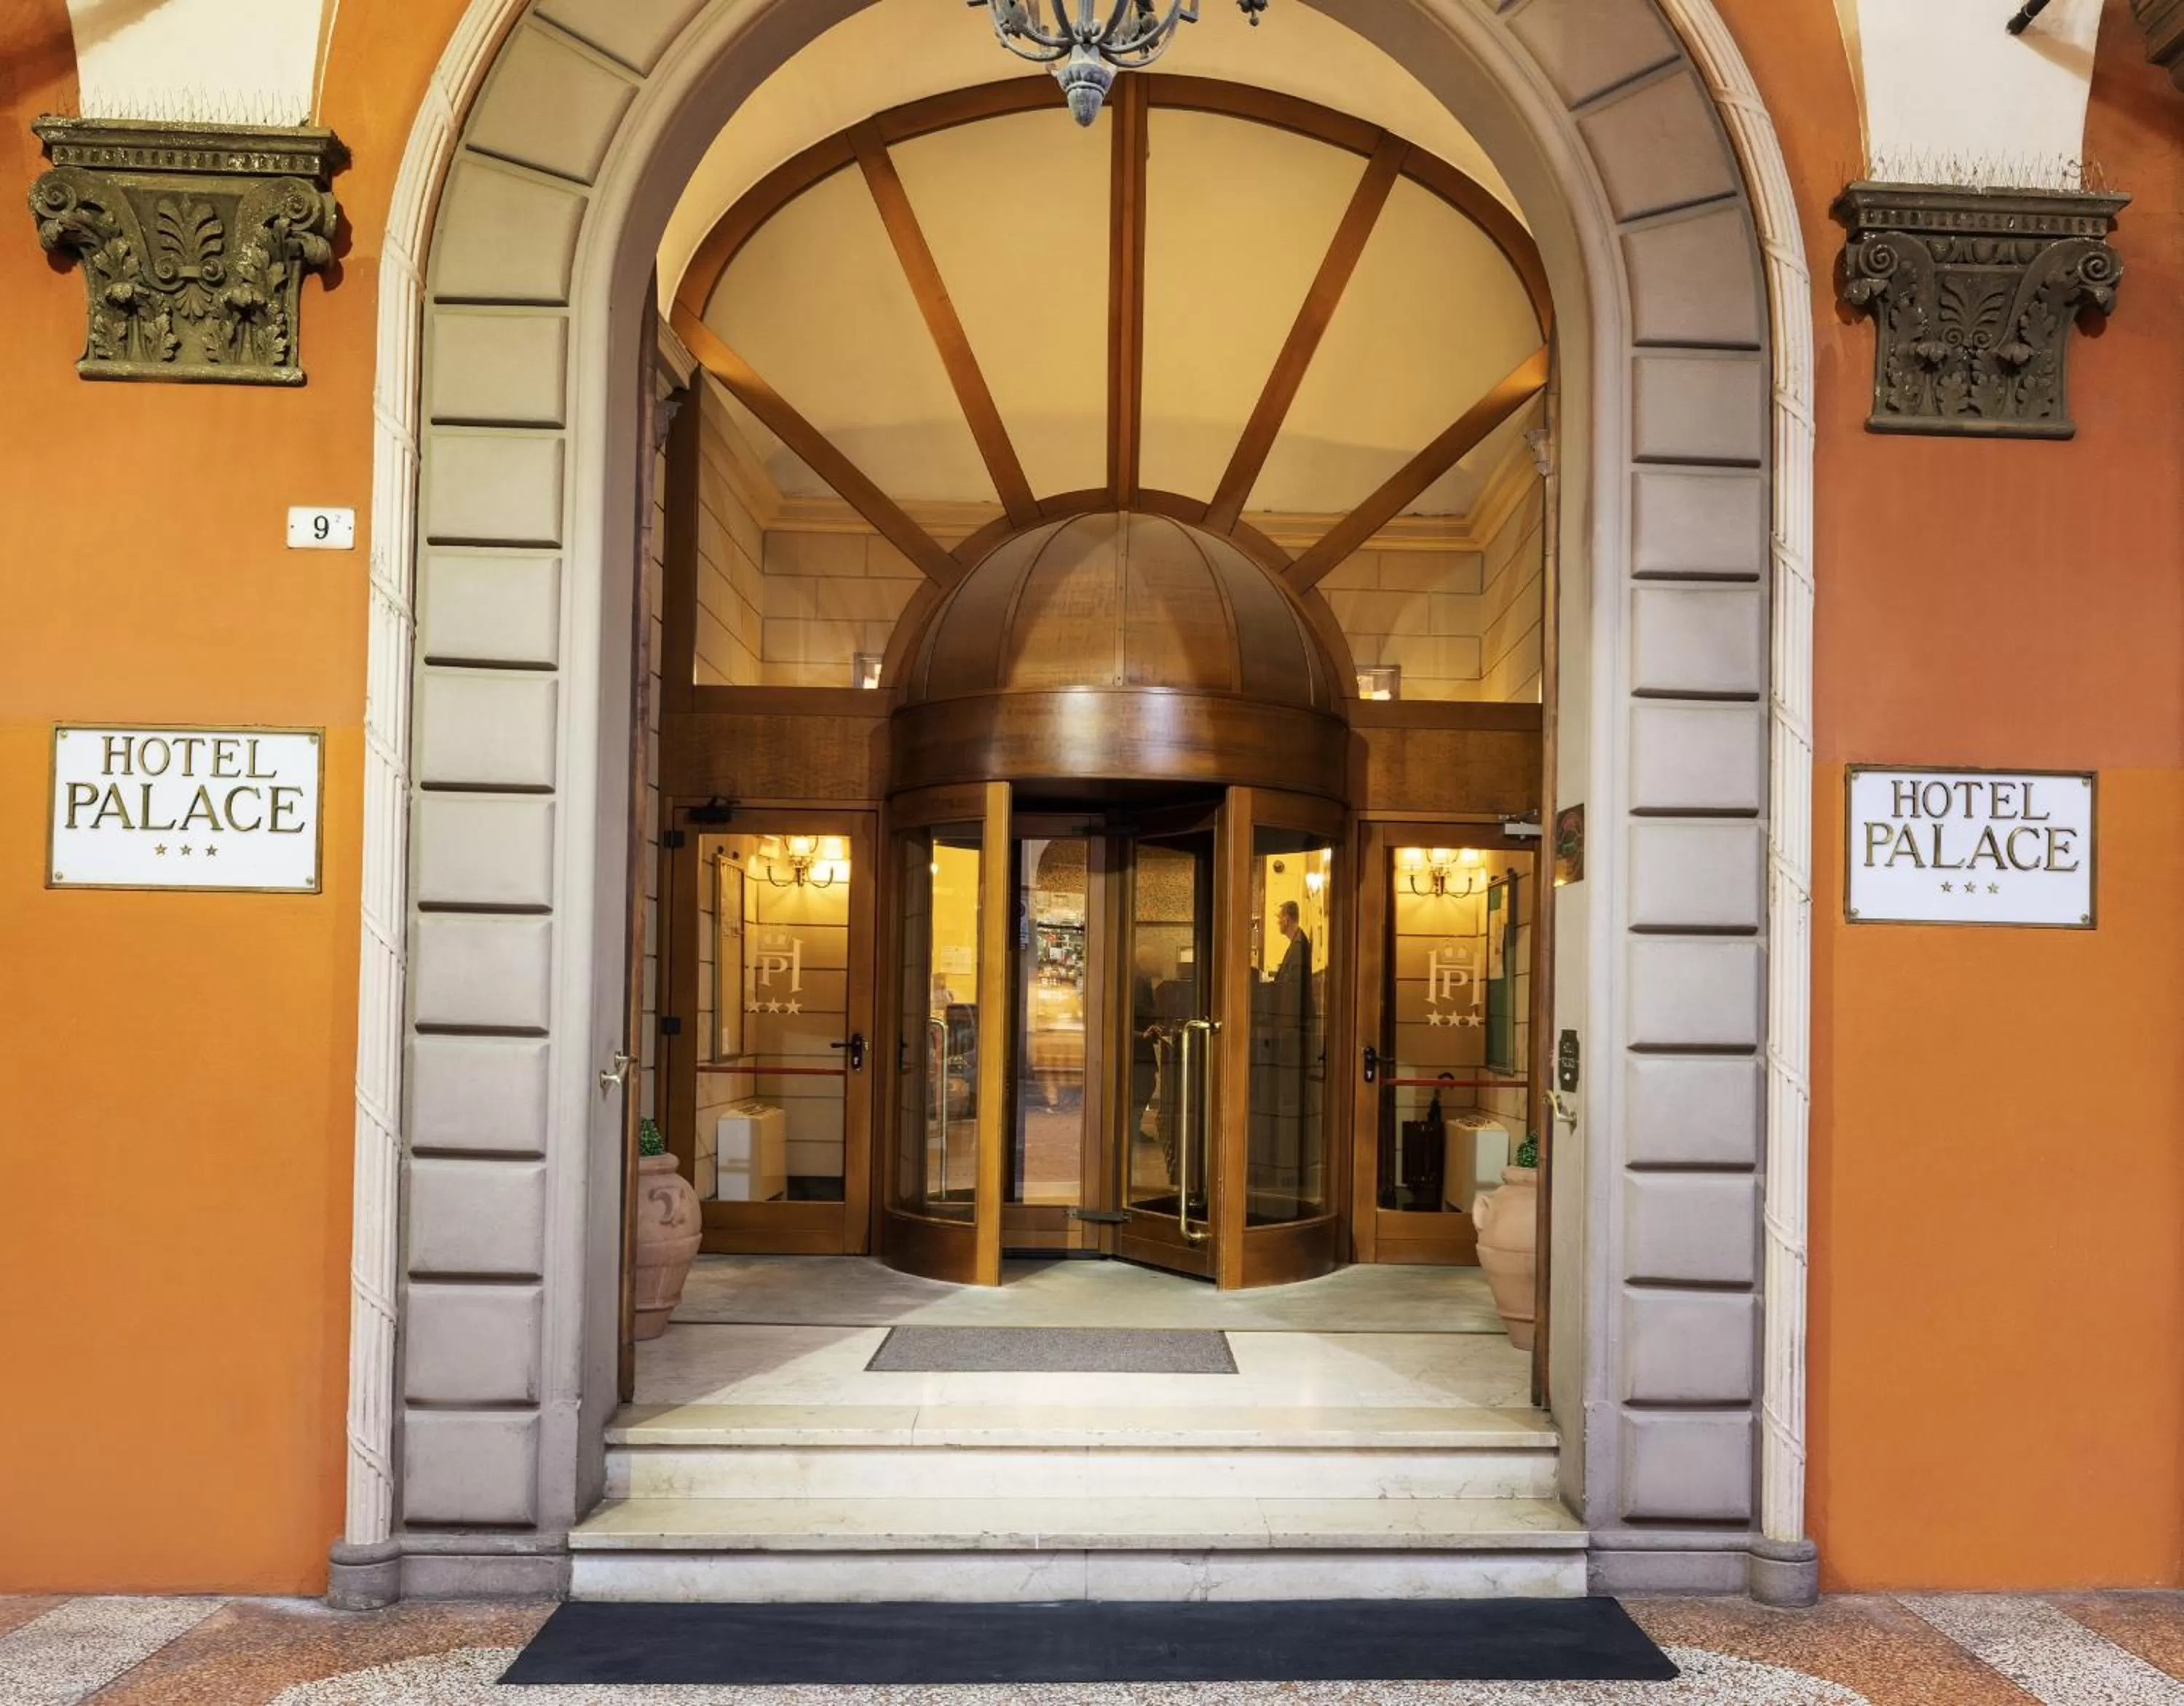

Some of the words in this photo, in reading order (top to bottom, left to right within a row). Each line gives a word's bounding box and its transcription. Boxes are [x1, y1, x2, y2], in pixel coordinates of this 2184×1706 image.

[314, 515, 330, 539] 9
[101, 736, 277, 778] HOTEL
[65, 782, 305, 833] PALACE
[1891, 780, 2051, 820] HOTEL
[1864, 822, 2079, 871] PALACE
